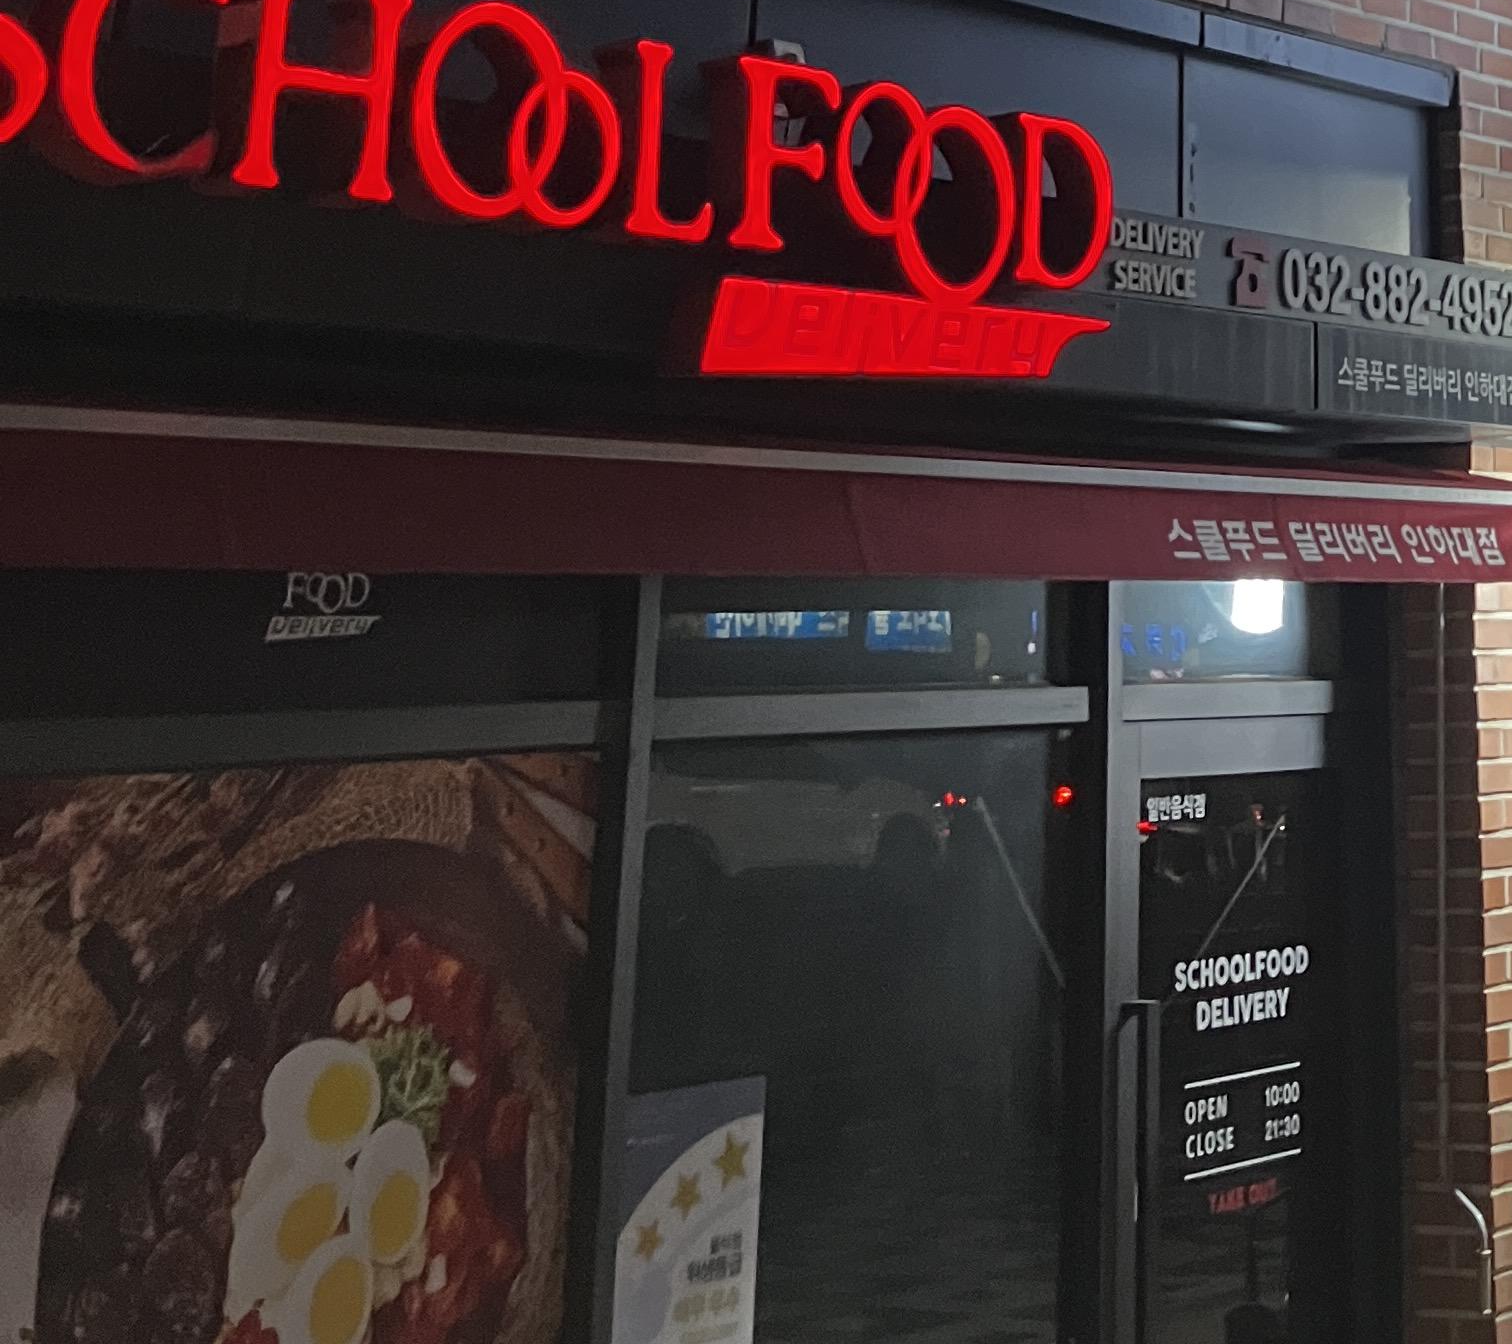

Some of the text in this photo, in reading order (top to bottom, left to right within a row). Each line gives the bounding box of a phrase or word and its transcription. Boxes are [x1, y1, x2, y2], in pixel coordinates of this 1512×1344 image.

[729, 52, 1114, 305] FOOD
[1110, 217, 1205, 259] DELIVERY
[1115, 260, 1197, 298] SERVICE
[1338, 357, 1401, 392] 스쿨푸드
[1403, 363, 1462, 401] 딜리버리
[1168, 518, 1506, 566] 스쿨푸드 딜리버리 인하대점
[282, 571, 370, 613] FOOD
[1147, 793, 1206, 822] 일반음식점
[1174, 945, 1309, 992] SCHOOLFOOD
[1196, 987, 1290, 1032] DELIVERY
[1184, 1081, 1300, 1125] OPEN 10:00
[1185, 1114, 1300, 1159] CLOSE 21:30
